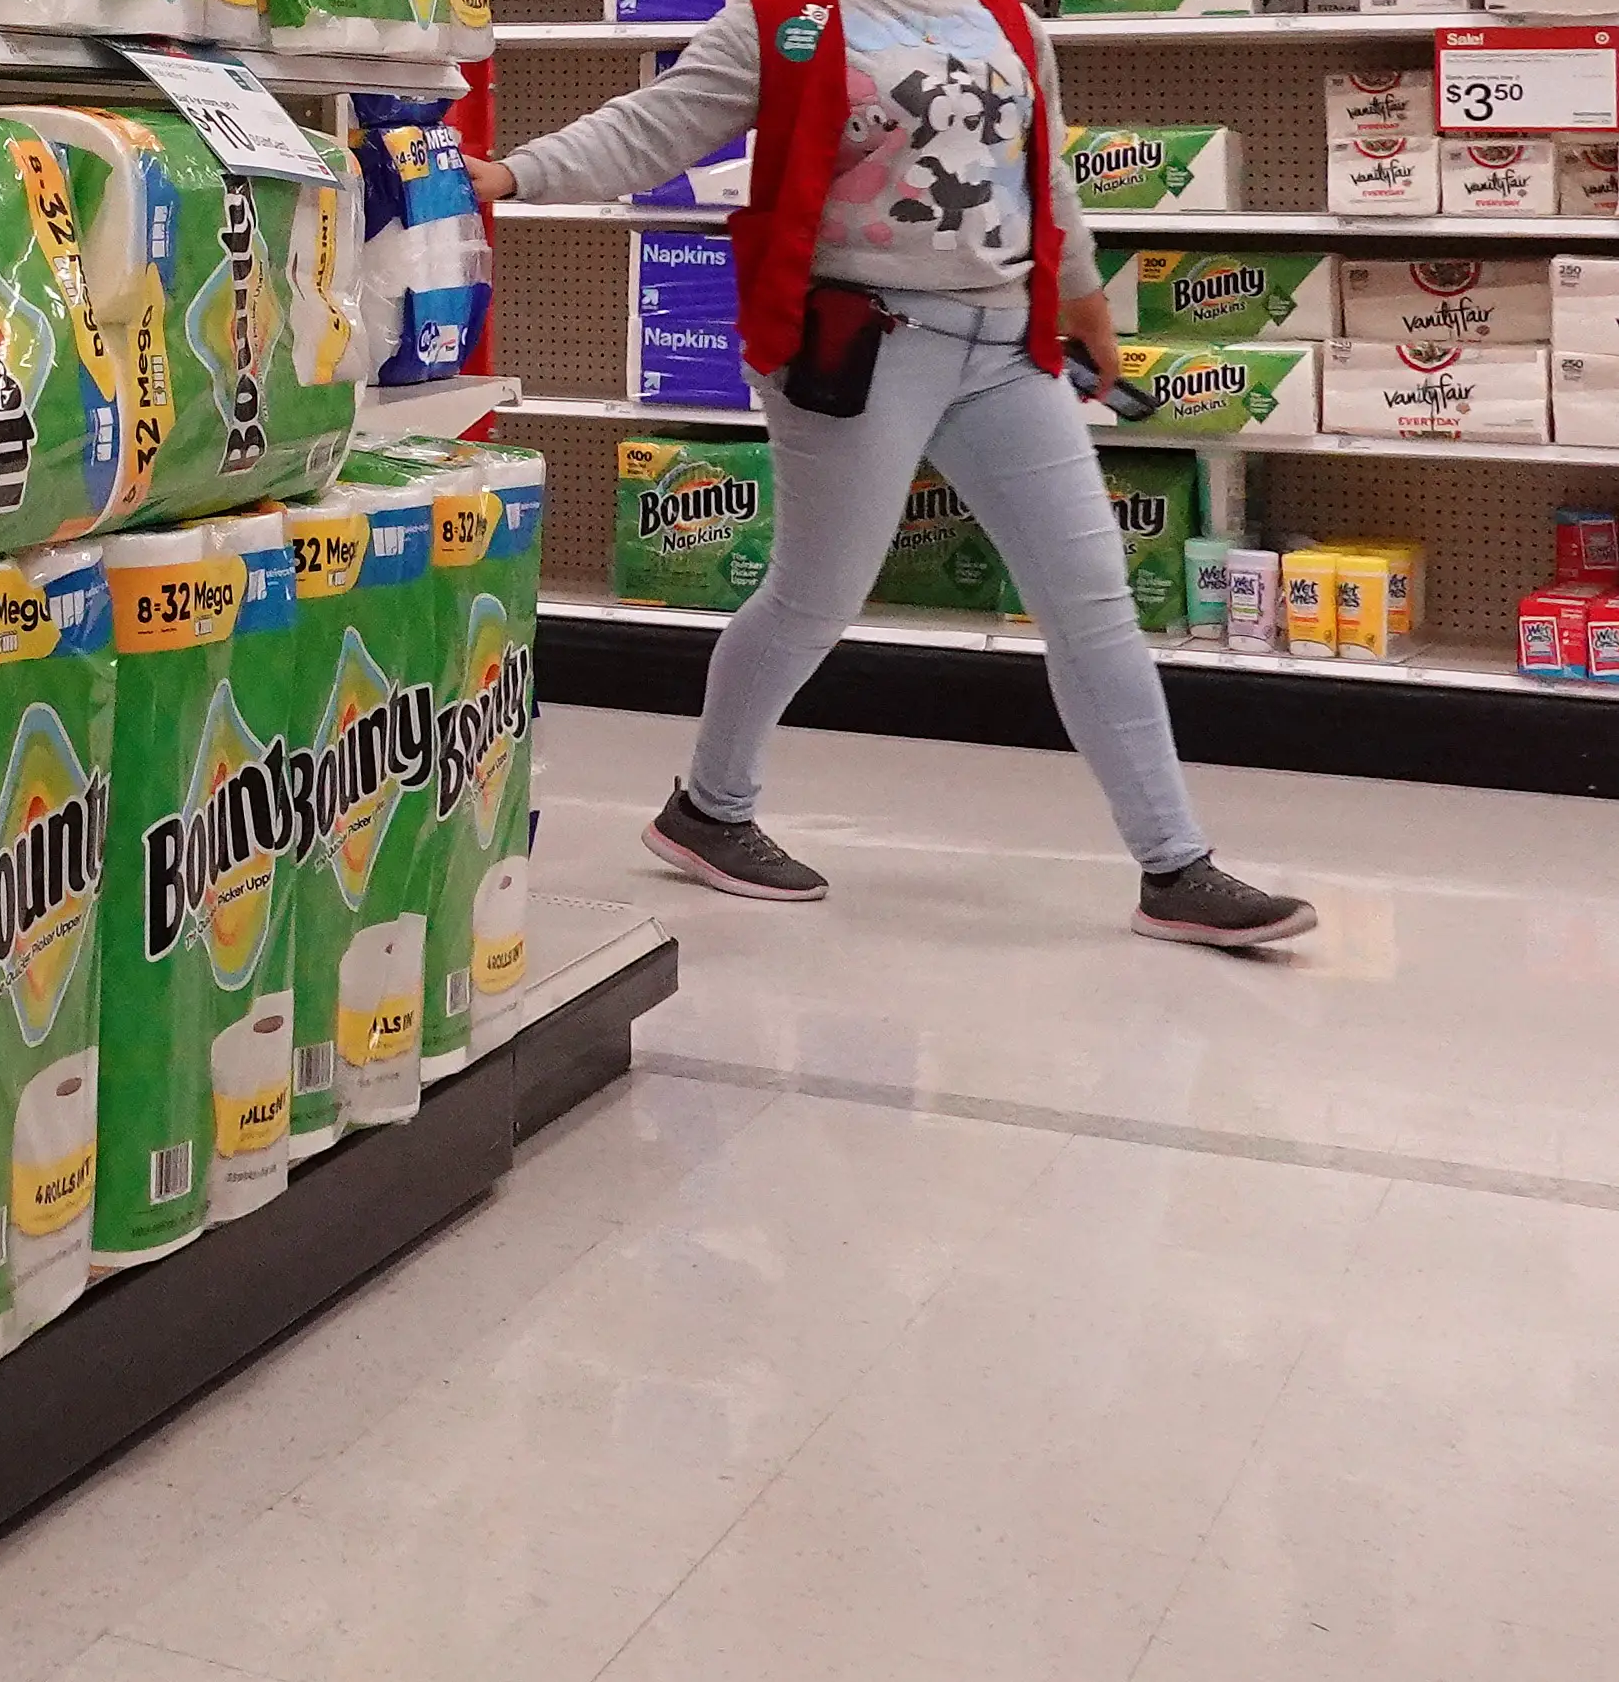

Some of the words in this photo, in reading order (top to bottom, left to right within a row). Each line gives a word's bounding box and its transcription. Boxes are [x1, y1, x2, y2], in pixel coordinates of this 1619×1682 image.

[1447, 33, 1484, 46] Sale!
[1074, 139, 1162, 183] Bounty
[1093, 174, 1146, 196] Napkins
[642, 243, 727, 267] Napkins
[1143, 258, 1167, 269] 200
[1174, 266, 1265, 312] Bounty
[1192, 301, 1246, 323] Napkins
[644, 327, 728, 351] Napkins
[1123, 352, 1147, 363] 200
[1154, 363, 1246, 406] Bounty
[1174, 397, 1228, 418] Napkins
[1398, 418, 1461, 427] EVERYDAY
[639, 477, 756, 537] Bounty
[663, 526, 732, 554] Napkins
[195, 580, 234, 617] Mega
[1289, 579, 1318, 594] Wet
[1290, 592, 1319, 606] Ones
[440, 645, 530, 820] Bounty
[287, 684, 434, 864] Bounty
